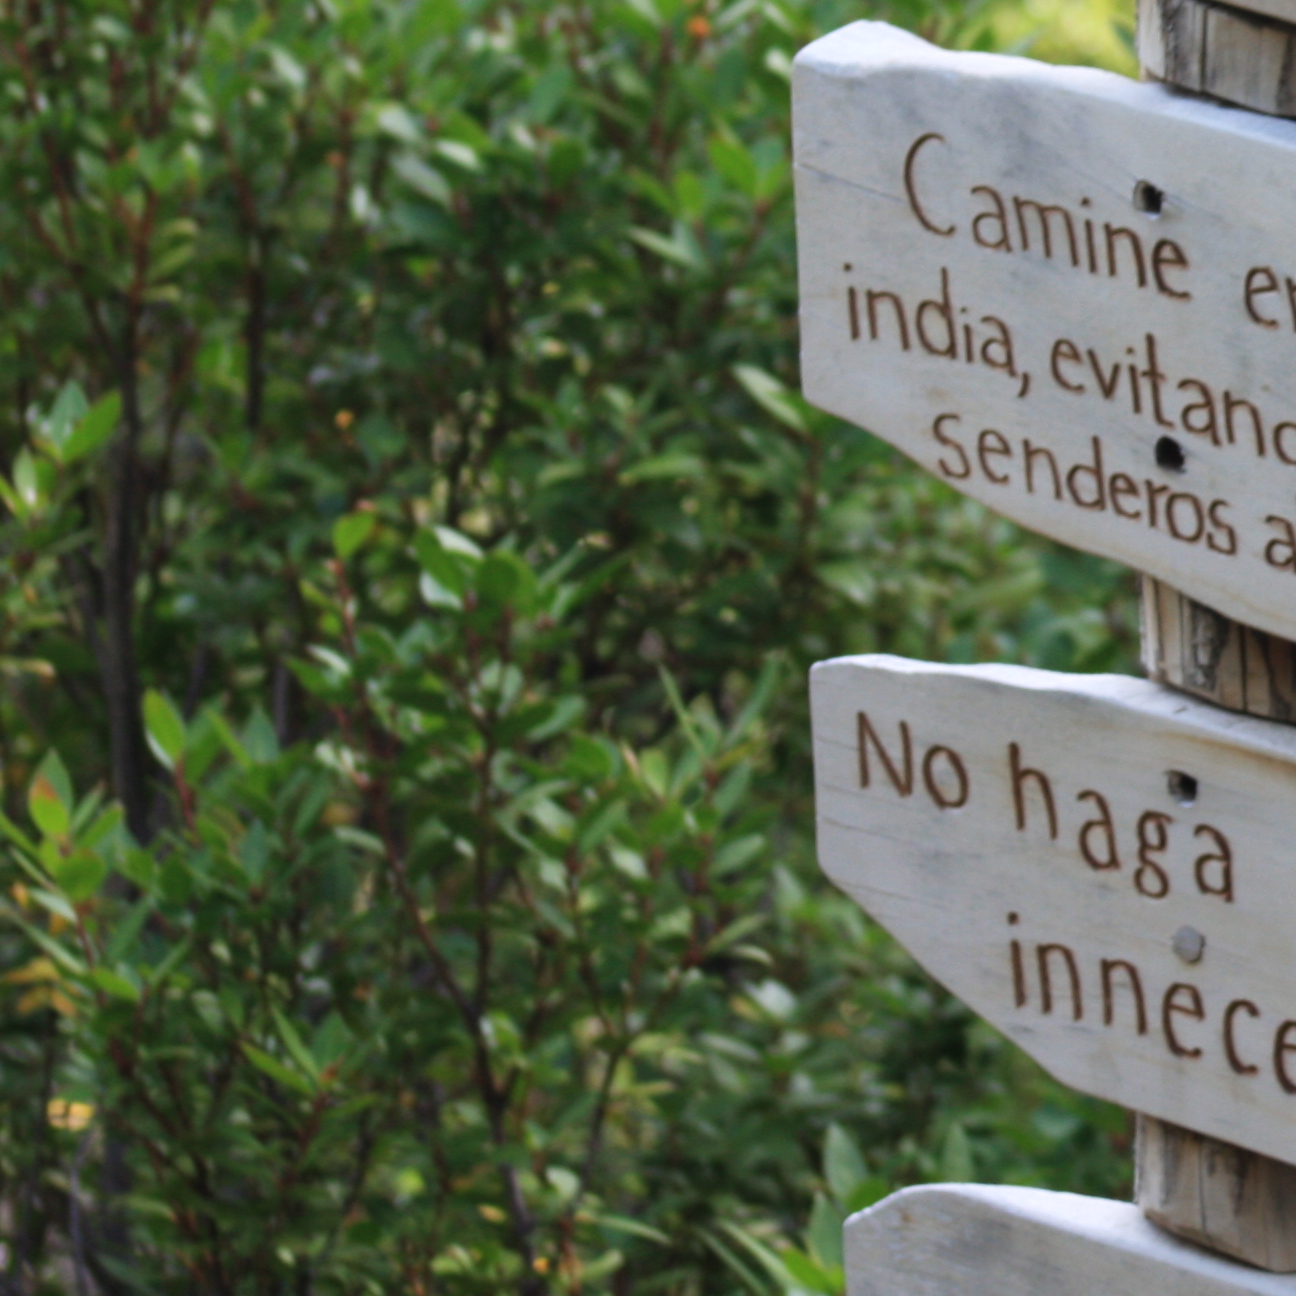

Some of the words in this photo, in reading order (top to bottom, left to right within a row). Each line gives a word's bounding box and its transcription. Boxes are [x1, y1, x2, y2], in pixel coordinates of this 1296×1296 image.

[903, 132, 1191, 301] Camine
[842, 263, 1031, 398] india,
[931, 413, 1239, 557] senderos
[856, 710, 969, 811] No
[1007, 741, 1236, 902] haga
